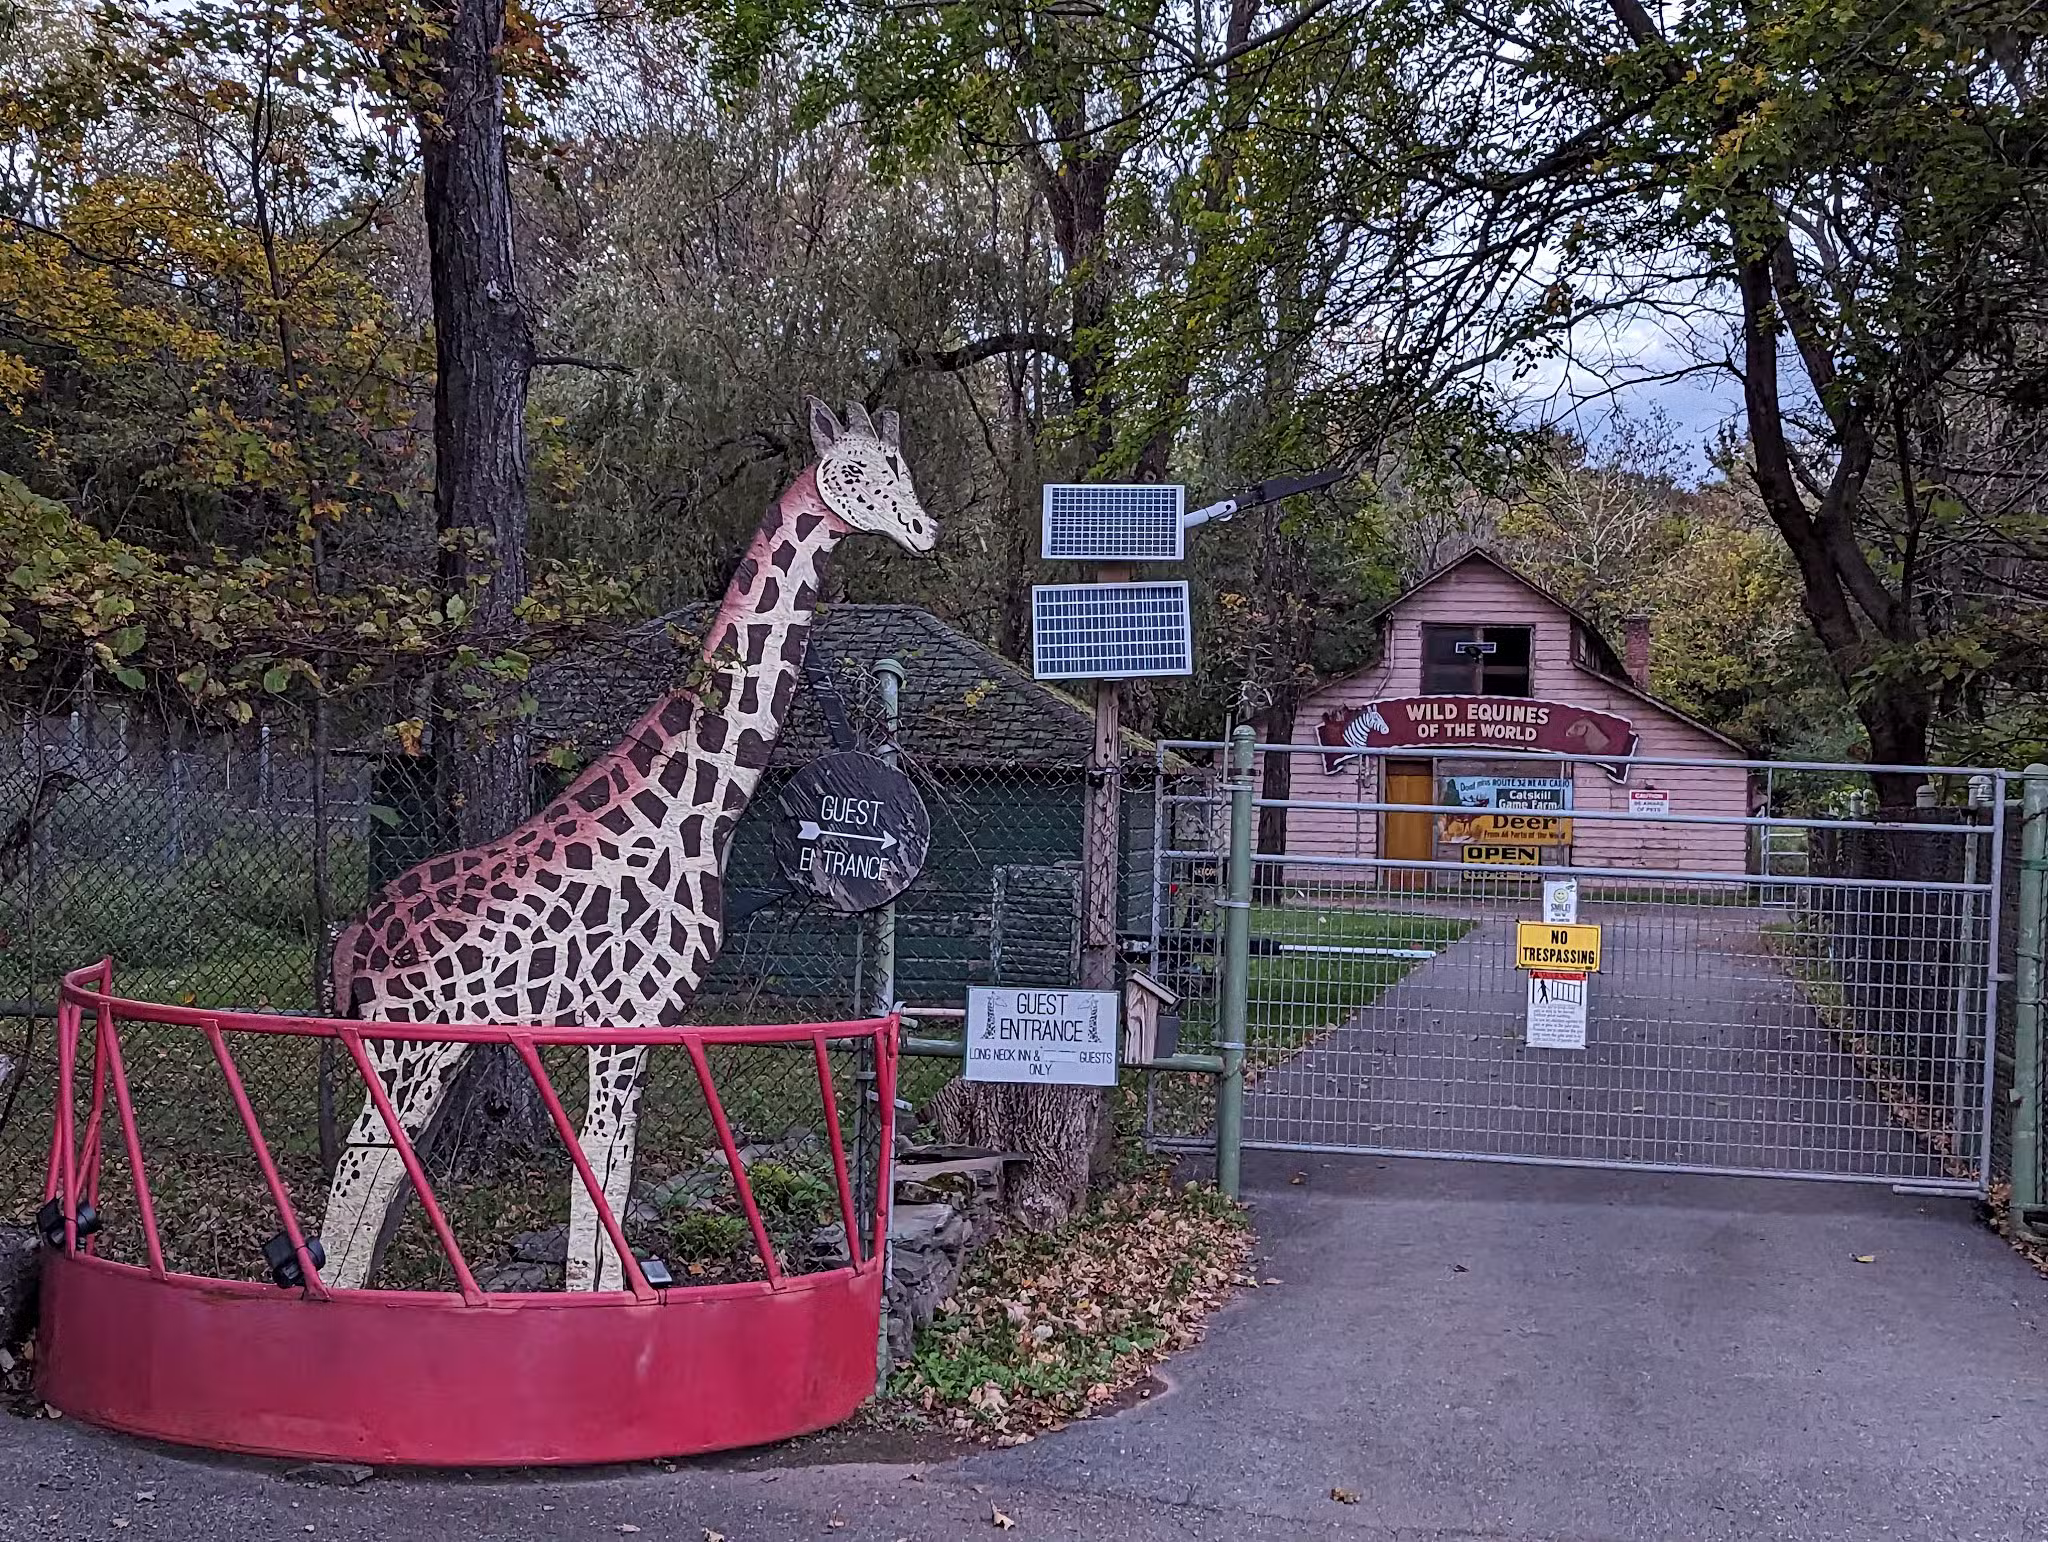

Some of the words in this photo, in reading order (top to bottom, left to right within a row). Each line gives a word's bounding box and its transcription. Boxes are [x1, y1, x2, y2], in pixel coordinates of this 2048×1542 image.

[1406, 703, 1458, 721] WILD
[1467, 704, 1550, 725] EQUINES
[1417, 723, 1438, 738] OF
[1444, 723, 1476, 737] THE
[1480, 724, 1537, 742] WORLD
[1492, 779, 1516, 787] ROUTE
[1517, 779, 1526, 787] 32
[1509, 790, 1551, 800] Catskill
[820, 795, 884, 826] GUEST
[1498, 799, 1528, 809] Game
[1531, 800, 1558, 810] Farm
[1492, 815, 1557, 830] Deer
[1467, 847, 1535, 860] OPEN
[1550, 930, 1568, 945] NO
[1522, 947, 1595, 965] TRESPASSING
[1017, 992, 1069, 1016] GUEST
[1000, 1018, 1084, 1042] ENTRANCE
[969, 1048, 991, 1060] LONG
[993, 1049, 1015, 1061] NECK
[1018, 1050, 1031, 1061] INN
[1033, 1050, 1041, 1062] &
[1079, 1051, 1113, 1064] GUESTS
[1029, 1063, 1053, 1076] ONLY
